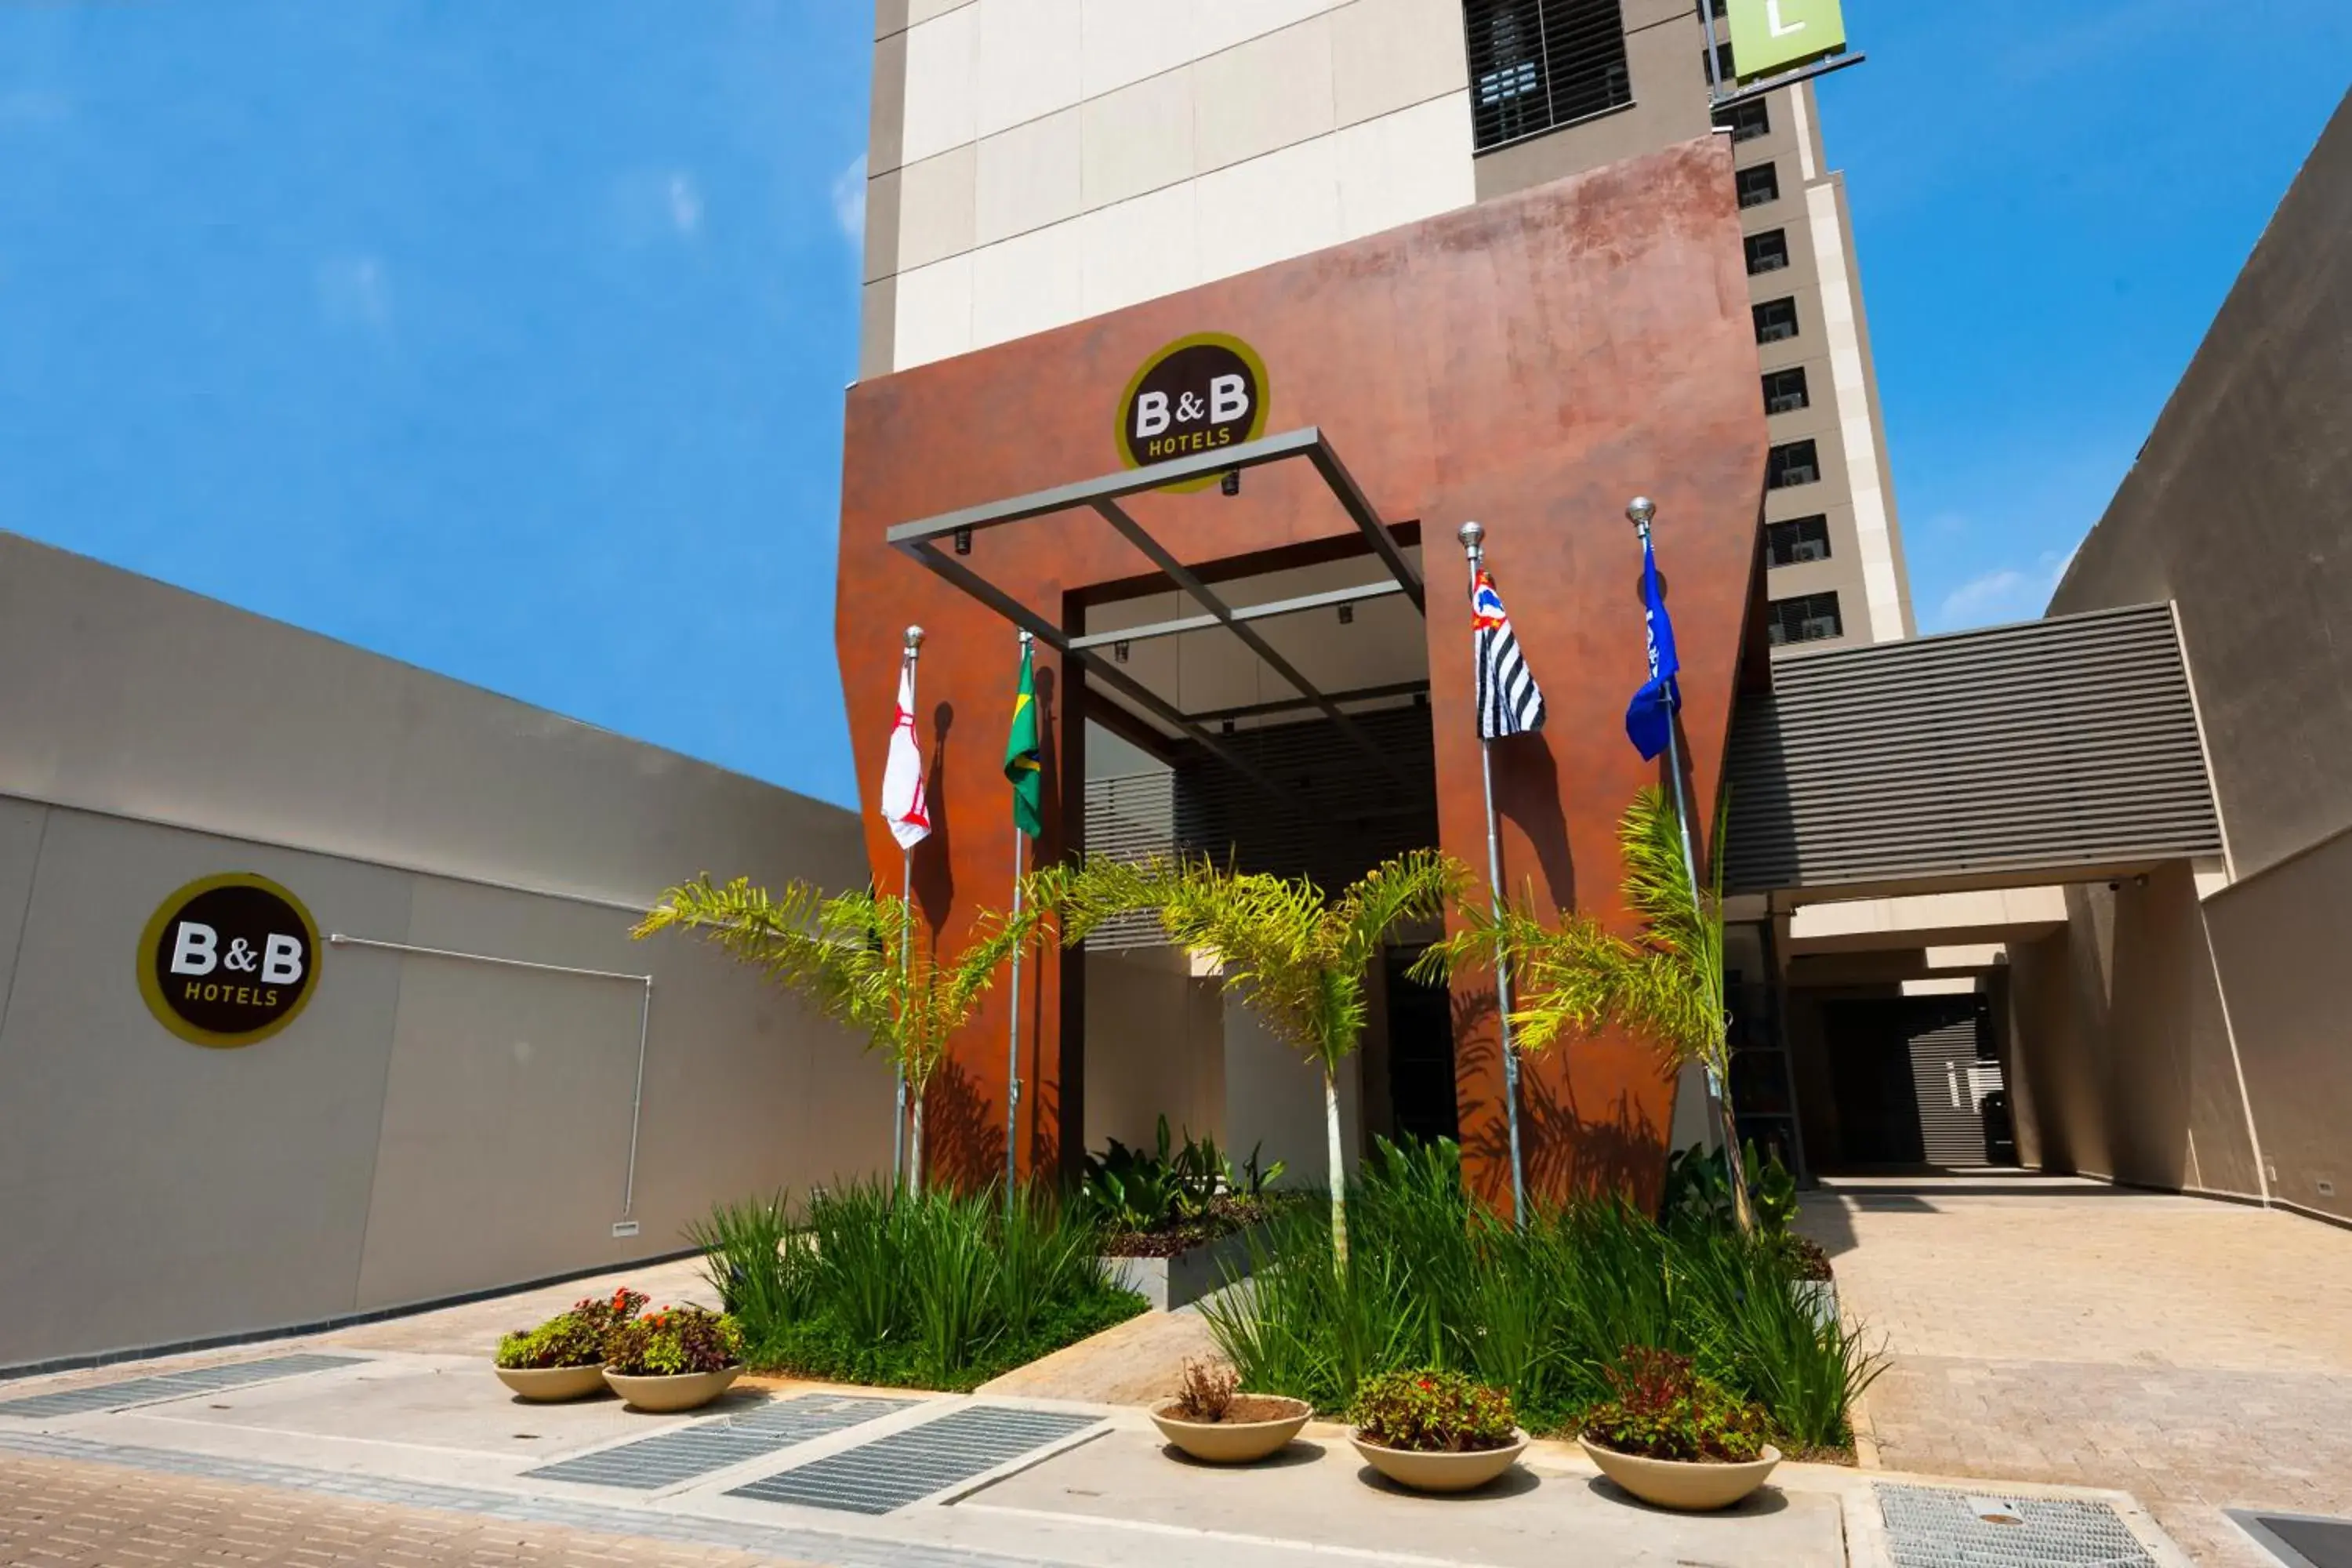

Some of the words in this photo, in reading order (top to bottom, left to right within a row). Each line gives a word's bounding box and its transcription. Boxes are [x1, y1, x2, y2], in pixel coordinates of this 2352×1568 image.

[1136, 374, 1249, 437] B&B
[1149, 427, 1230, 456] HOTELS
[171, 920, 303, 985] B&B
[185, 982, 278, 1006] HOTELS
